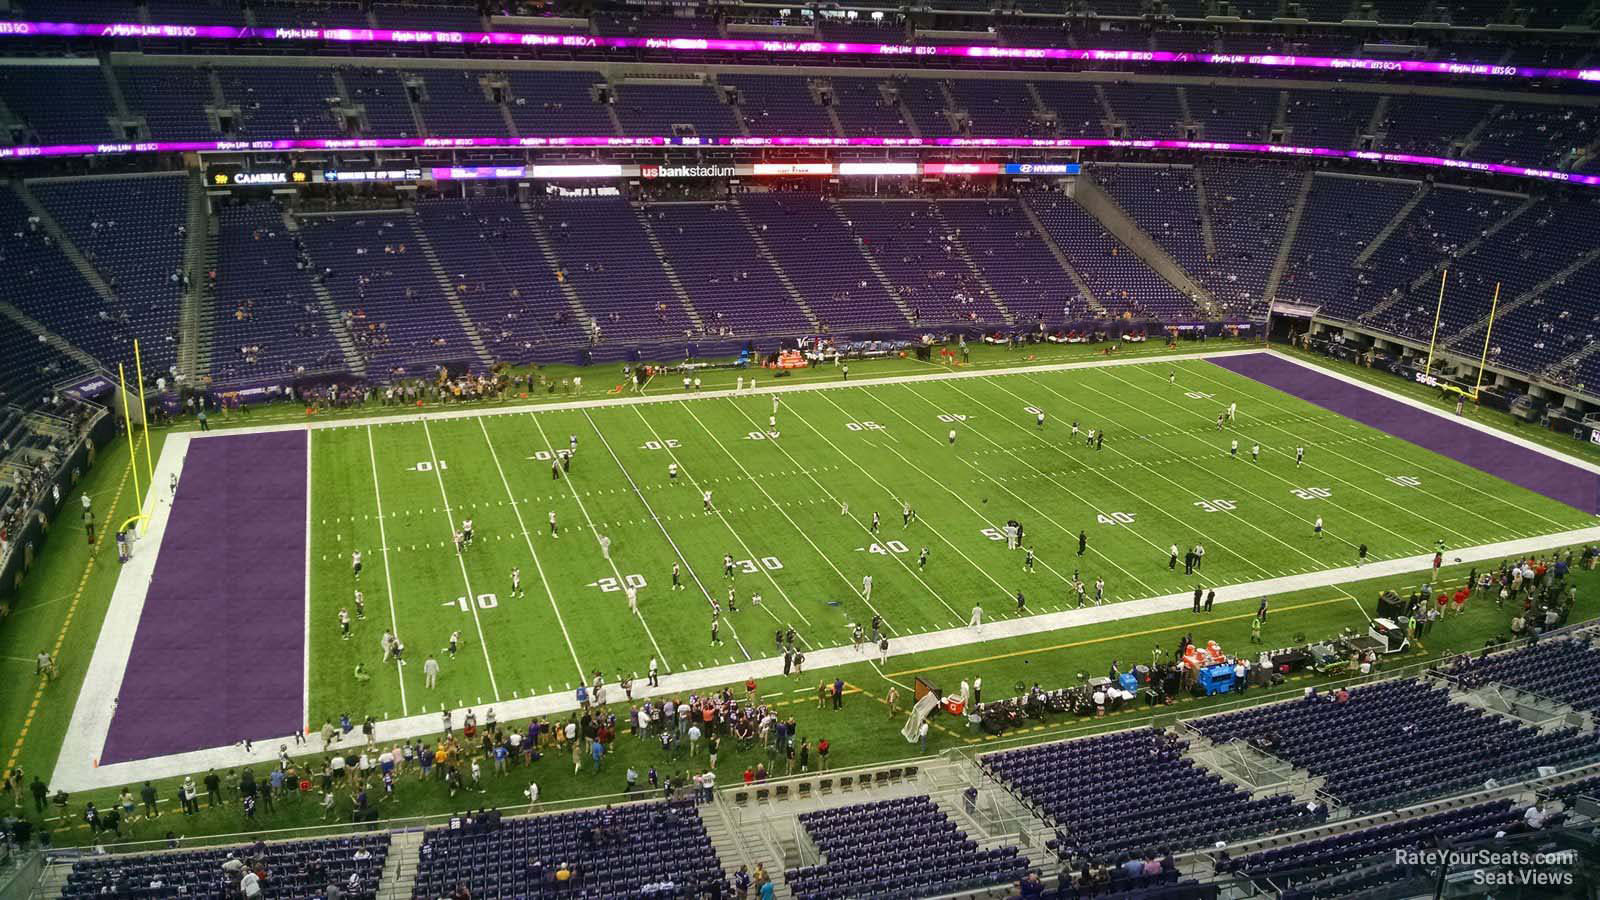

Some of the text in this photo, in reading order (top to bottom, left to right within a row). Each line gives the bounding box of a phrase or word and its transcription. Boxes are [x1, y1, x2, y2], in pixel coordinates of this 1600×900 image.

[1033, 164, 1067, 173] HYUNDAI
[233, 172, 287, 183] CAMBRIA
[1097, 511, 1135, 526] 40
[868, 540, 909, 556] 40
[736, 556, 784, 574] 30
[597, 573, 648, 593] 20
[457, 593, 498, 613] 10
